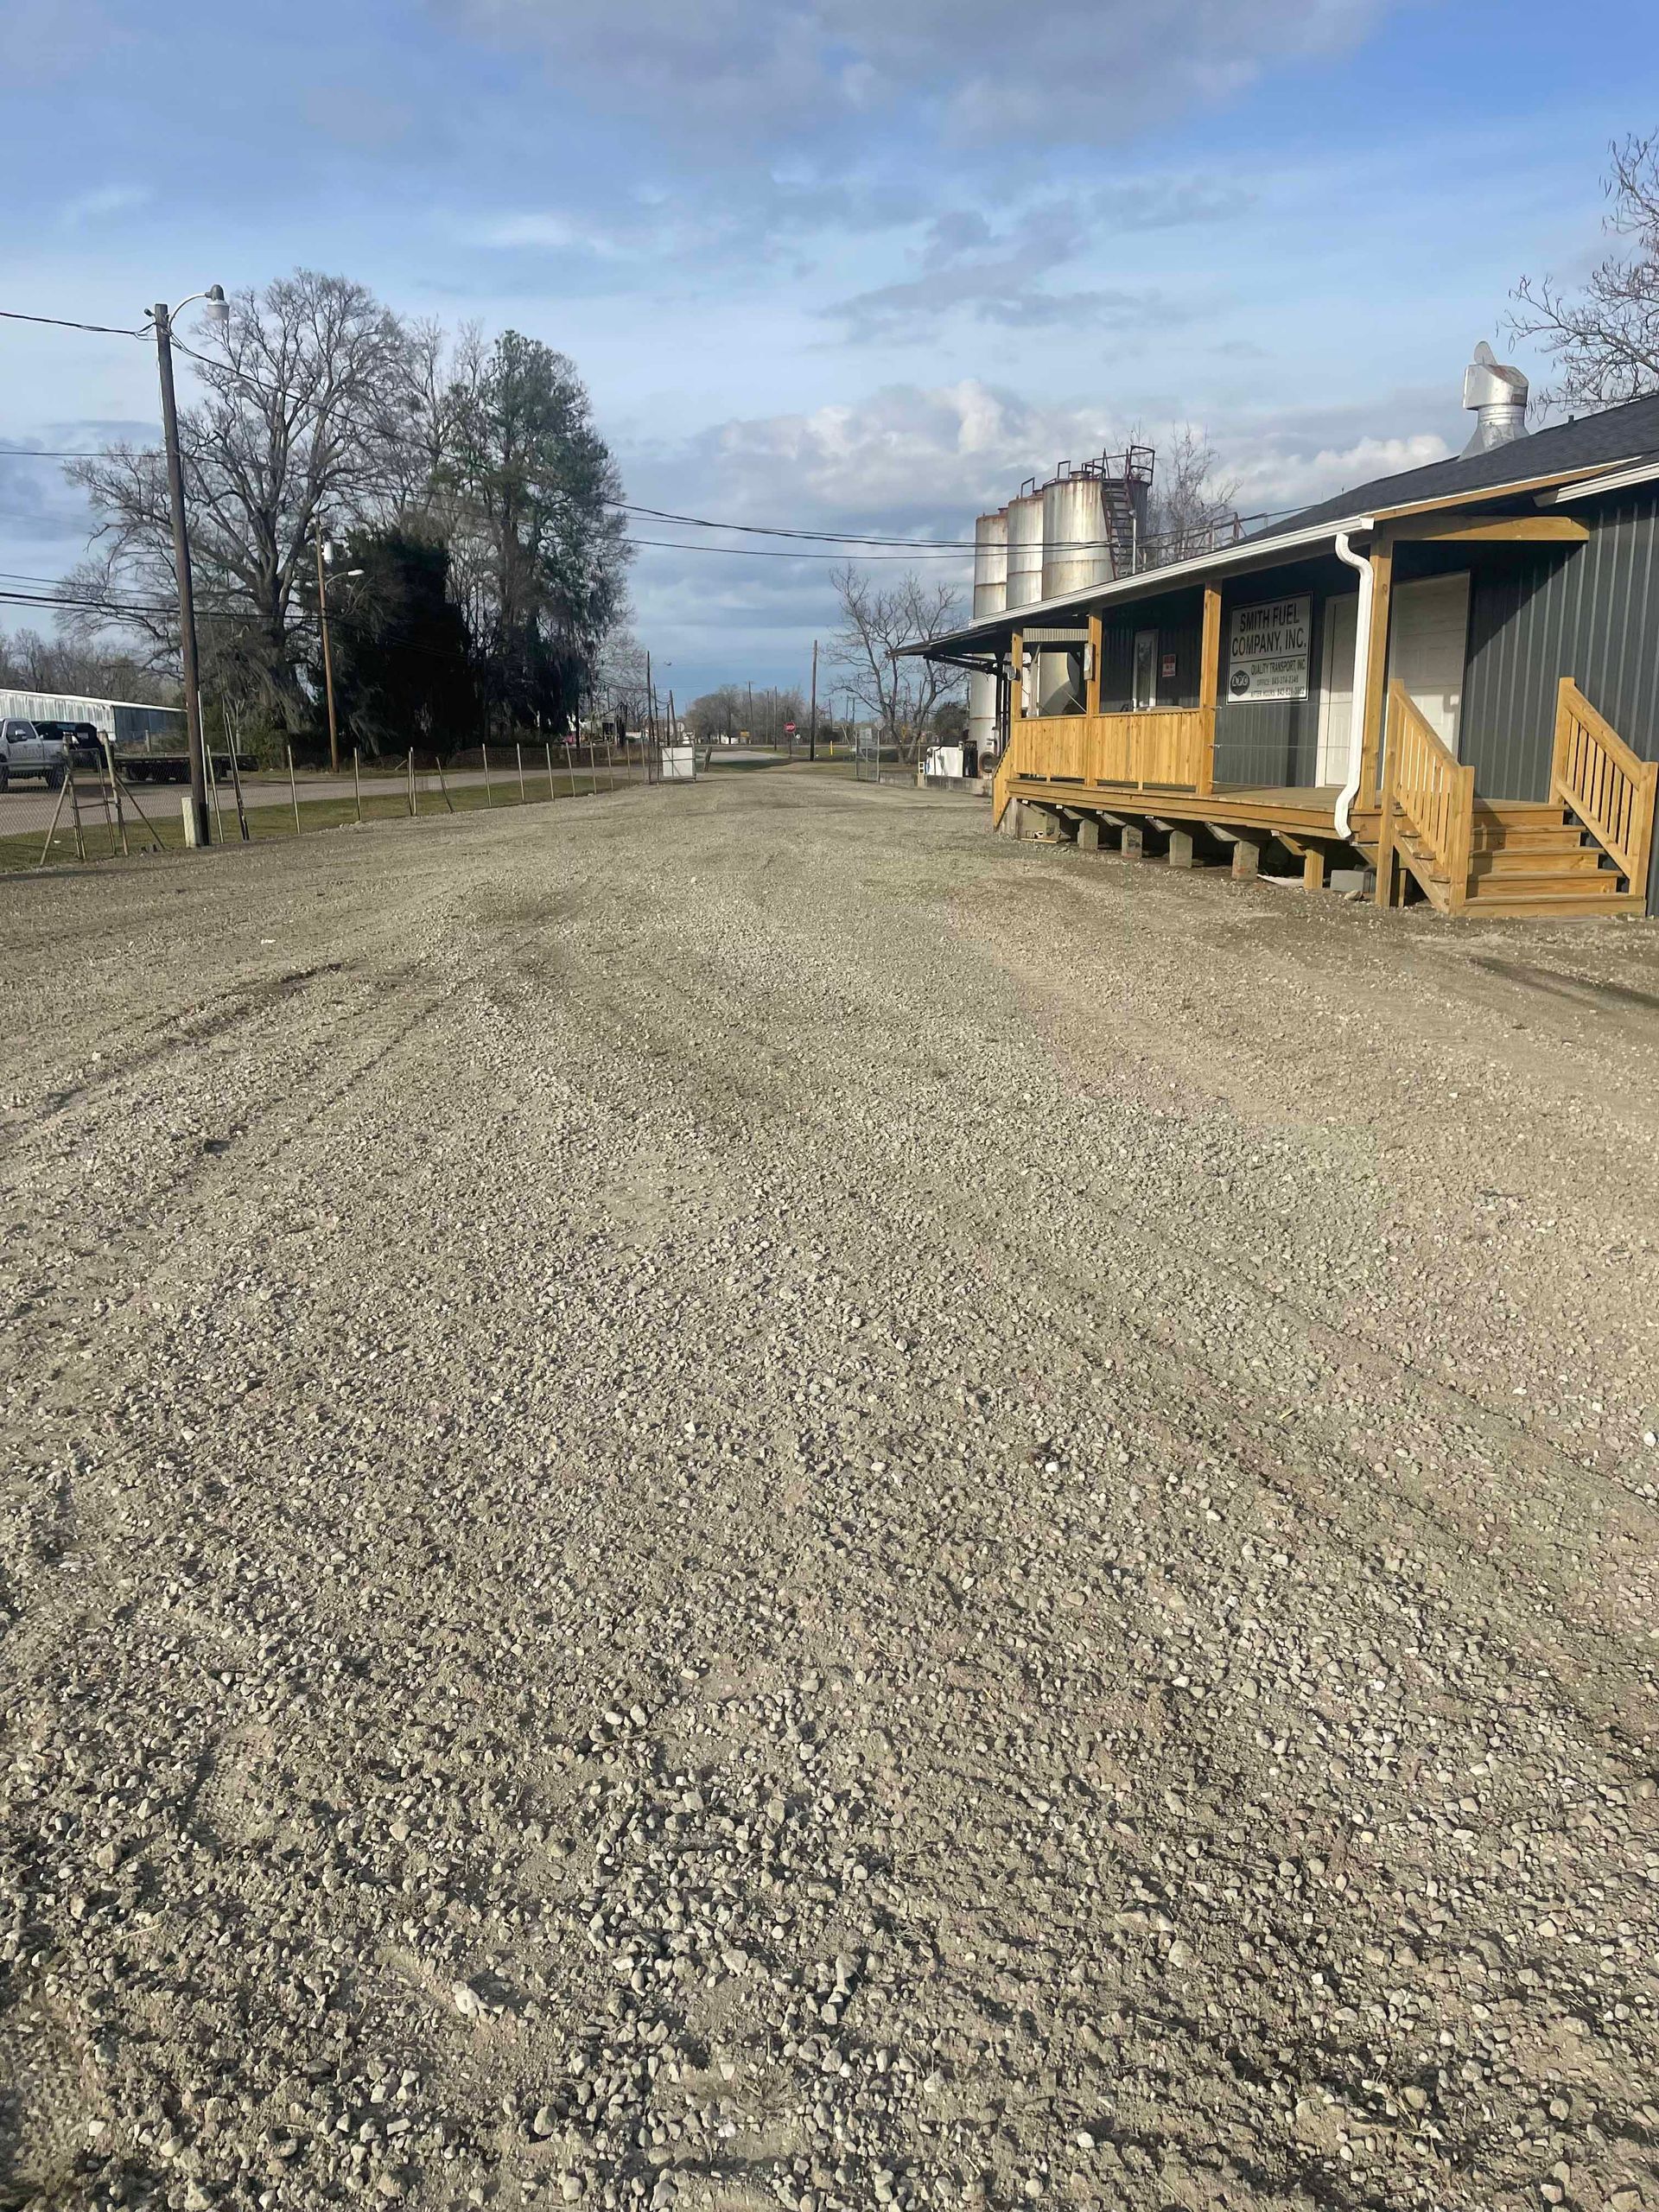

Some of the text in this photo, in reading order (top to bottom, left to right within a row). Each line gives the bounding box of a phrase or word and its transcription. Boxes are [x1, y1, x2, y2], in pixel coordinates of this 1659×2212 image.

[1240, 603, 1300, 632] SMITH FUEL
[1232, 627, 1306, 657] COMPANY, INC.
[1251, 663, 1268, 675] QUALITY
